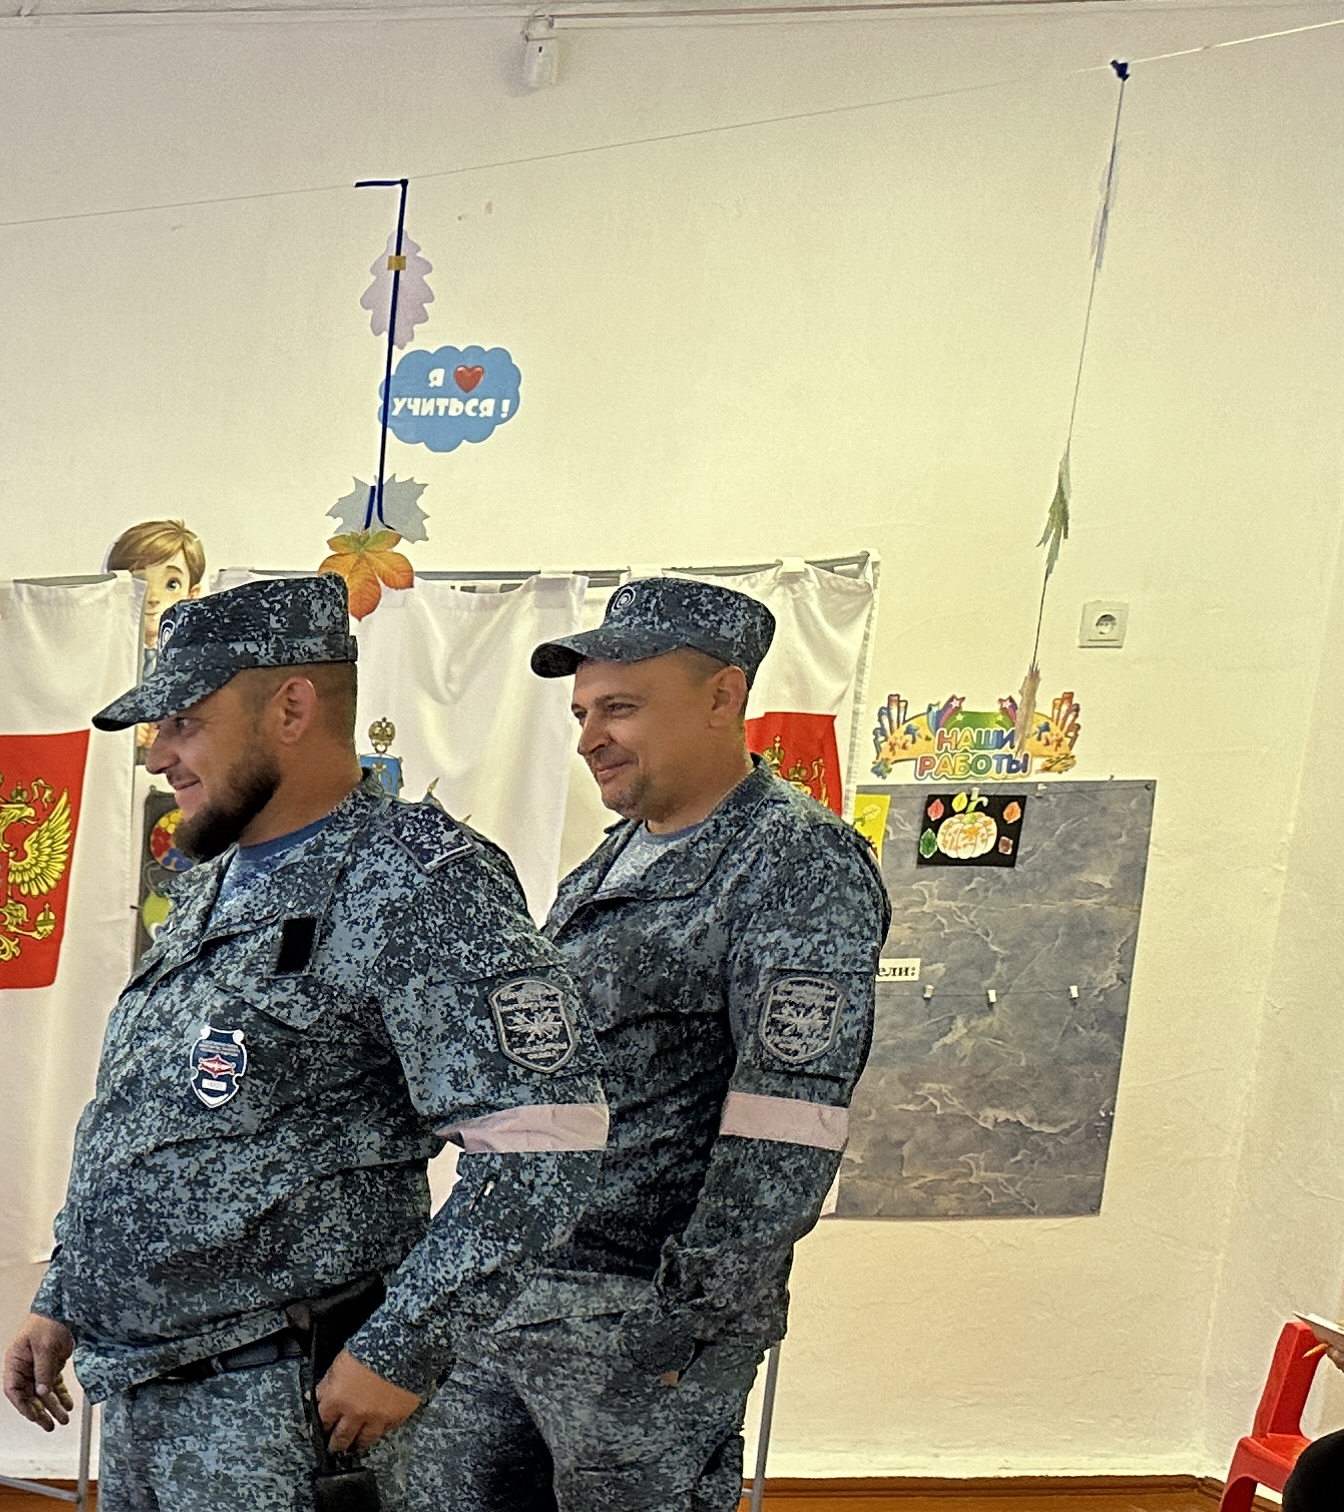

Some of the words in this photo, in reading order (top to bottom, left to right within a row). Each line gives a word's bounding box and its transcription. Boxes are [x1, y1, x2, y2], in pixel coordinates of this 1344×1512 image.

[429, 368, 445, 388] Я
[392, 397, 495, 418] УЧИТЬСЯ
[936, 727, 1016, 751] НАШИ
[918, 753, 1029, 777] РАБОТЫ
